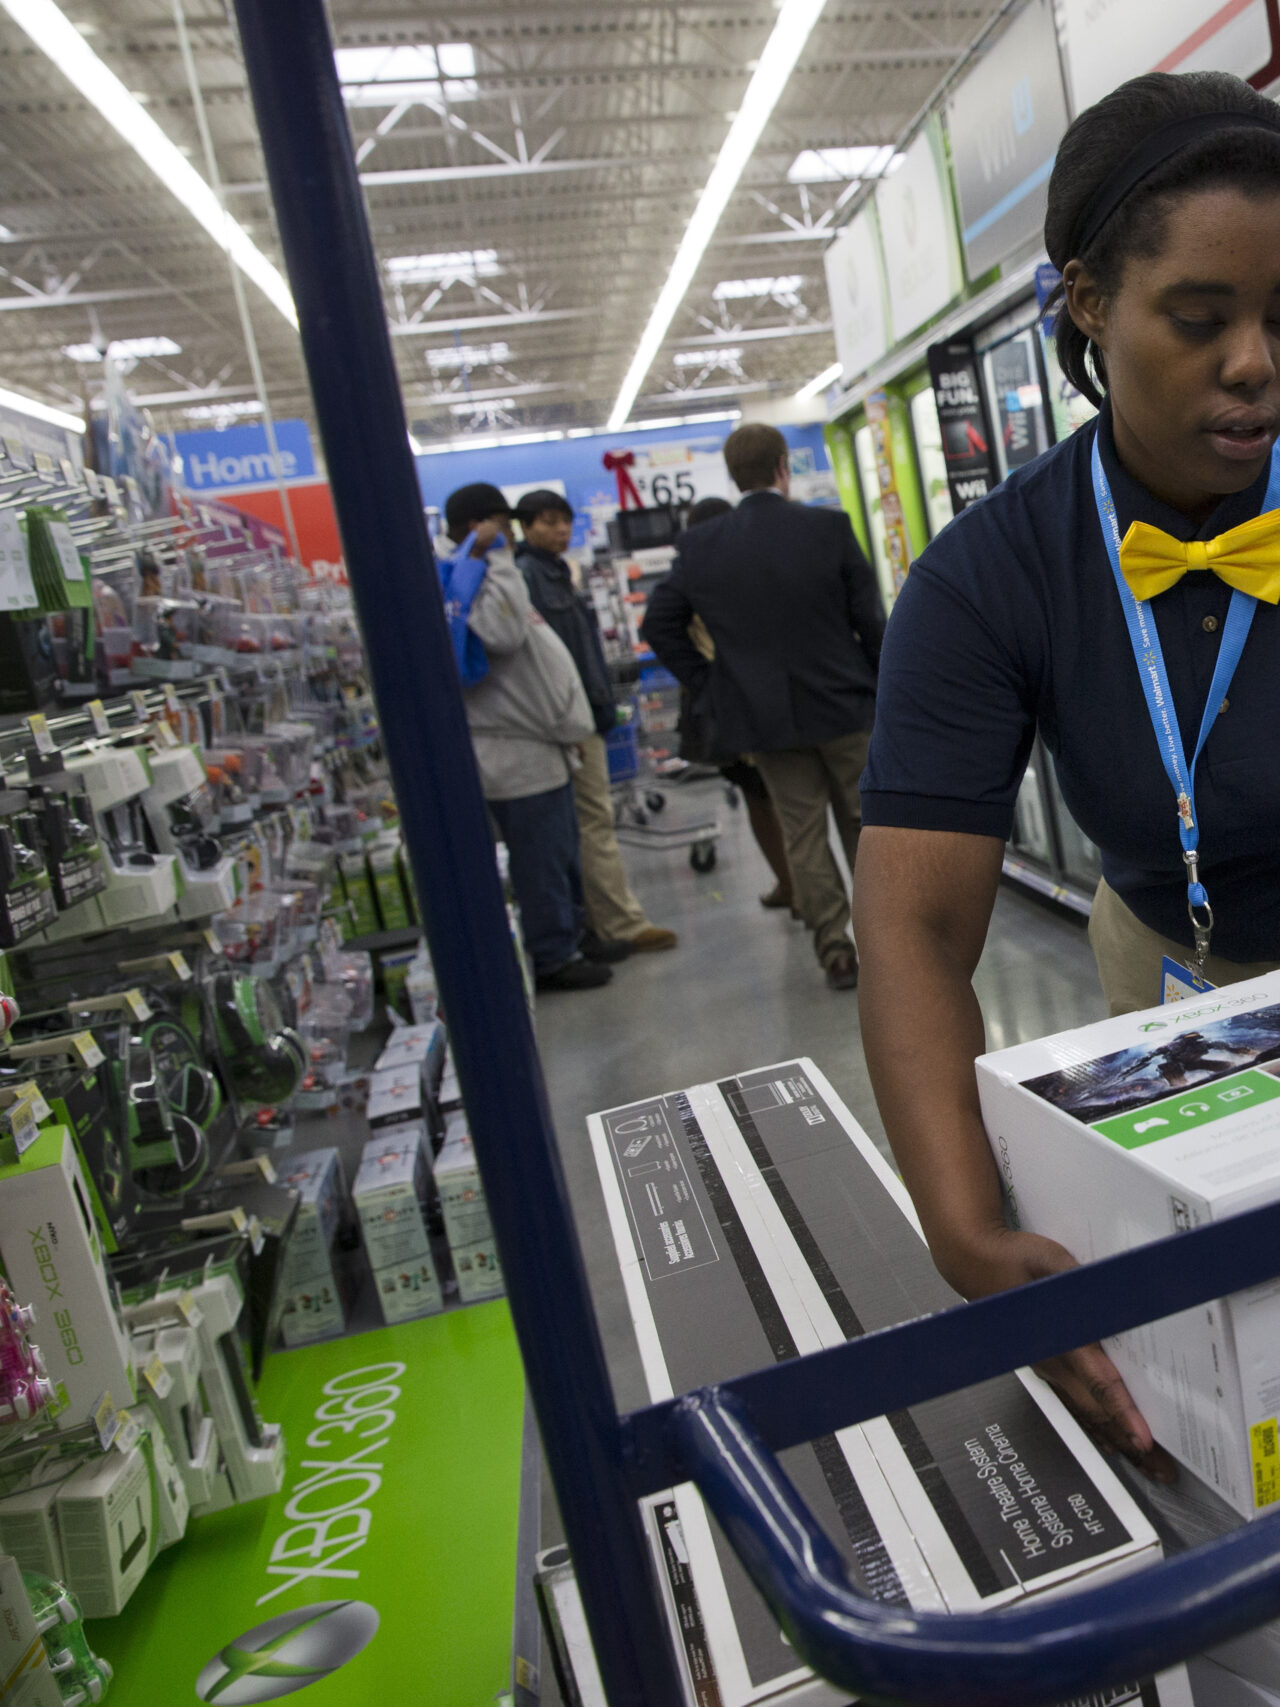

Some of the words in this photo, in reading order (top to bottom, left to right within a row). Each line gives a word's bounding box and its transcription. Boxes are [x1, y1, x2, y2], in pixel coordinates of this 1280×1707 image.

[936, 388, 979, 407] FUN.
[938, 370, 970, 391] BIG
[190, 450, 298, 487] Home
[954, 479, 988, 501] Wii
[1107, 513, 1123, 556] almart
[1142, 629, 1151, 648] Save
[1147, 665, 1165, 708] Walmart
[1167, 735, 1176, 753] Live
[1174, 1003, 1223, 1024] XBOX
[1227, 992, 1270, 1008] 360
[998, 1135, 1013, 1181] 360
[28, 1225, 64, 1301] XBOX
[53, 1307, 84, 1368] 360
[305, 1360, 407, 1449] 360
[963, 1437, 998, 1479] System
[987, 1475, 1022, 1523] Theatre
[1009, 1462, 1041, 1499] Home
[254, 1436, 390, 1607] XBOX
[1067, 1492, 1105, 1536] HT-CT60
[1012, 1517, 1047, 1560] Home
